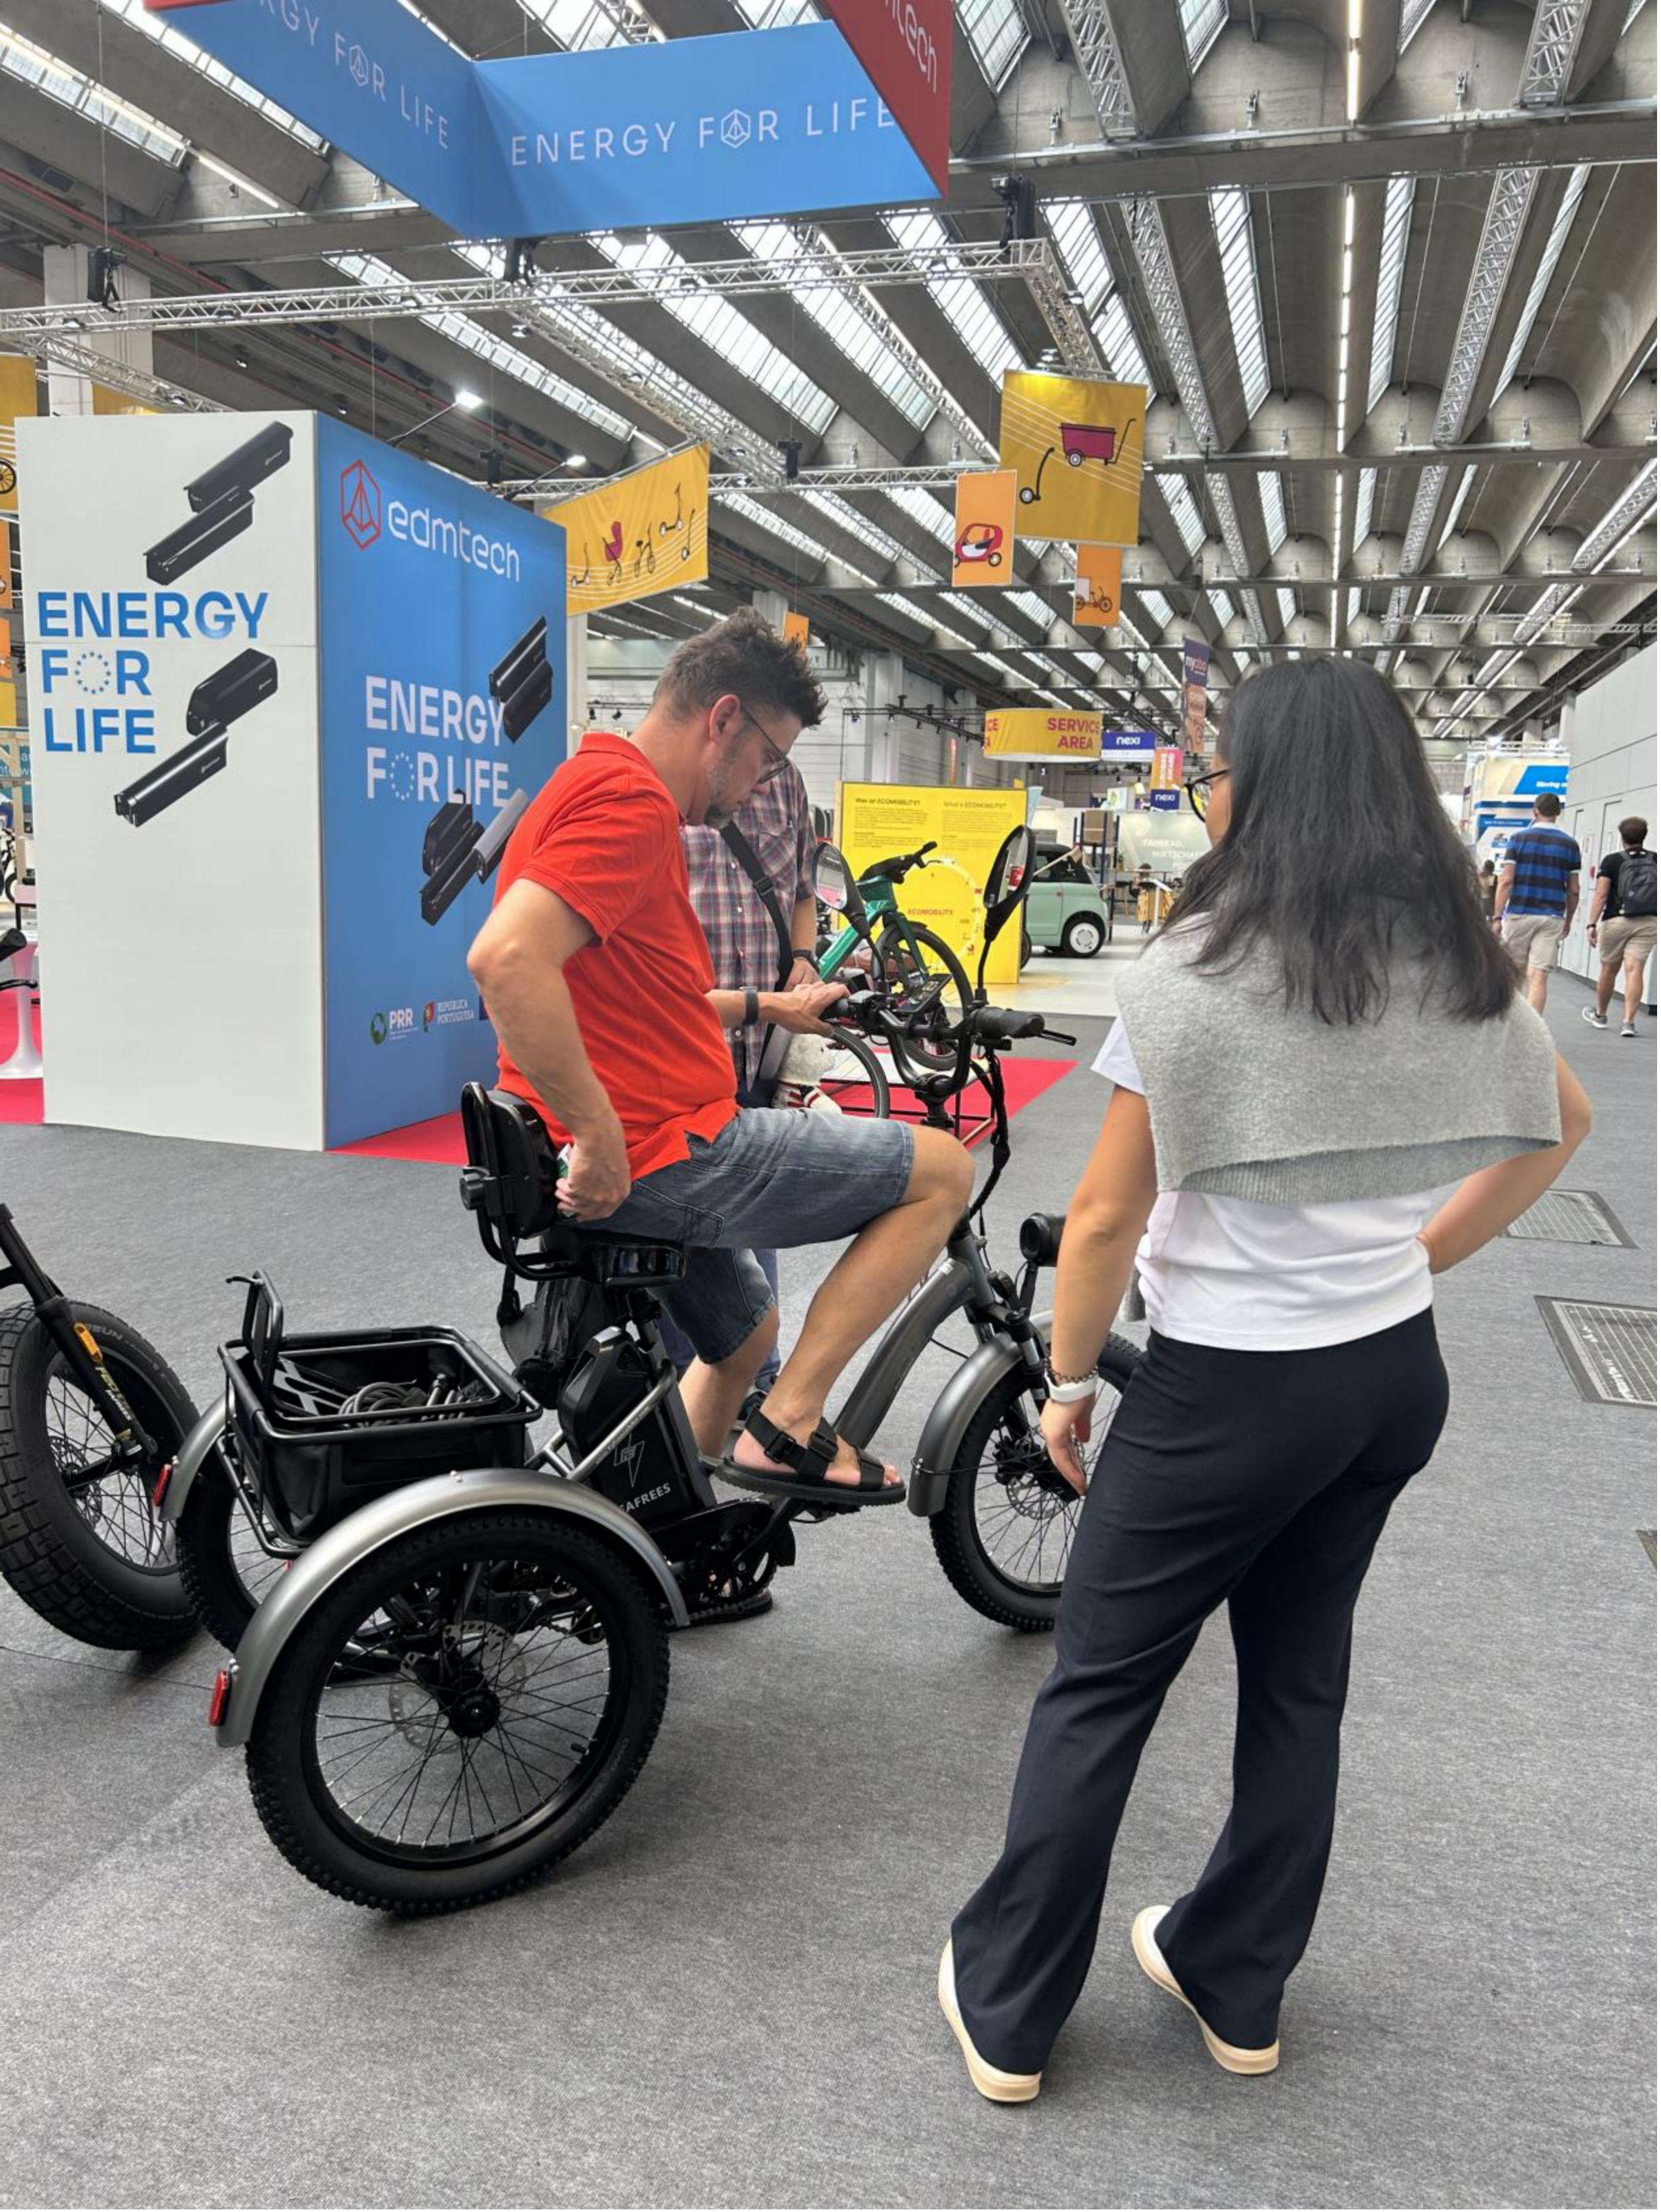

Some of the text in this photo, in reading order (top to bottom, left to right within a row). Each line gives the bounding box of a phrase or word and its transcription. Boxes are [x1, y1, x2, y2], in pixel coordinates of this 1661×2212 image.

[401, 84, 448, 149] LIFE
[512, 120, 675, 166] ENERGY
[807, 98, 895, 136] LIFE
[388, 501, 519, 582] edmtech
[37, 591, 269, 639] ENERGY
[44, 708, 156, 753] LIFE
[365, 675, 504, 747] ENERGY
[1058, 735, 1093, 750] AREA
[1116, 736, 1141, 745] nexi
[447, 756, 509, 808] LIFE
[390, 1008, 413, 1029] PRR
[618, 1483, 671, 1513] AFREES
